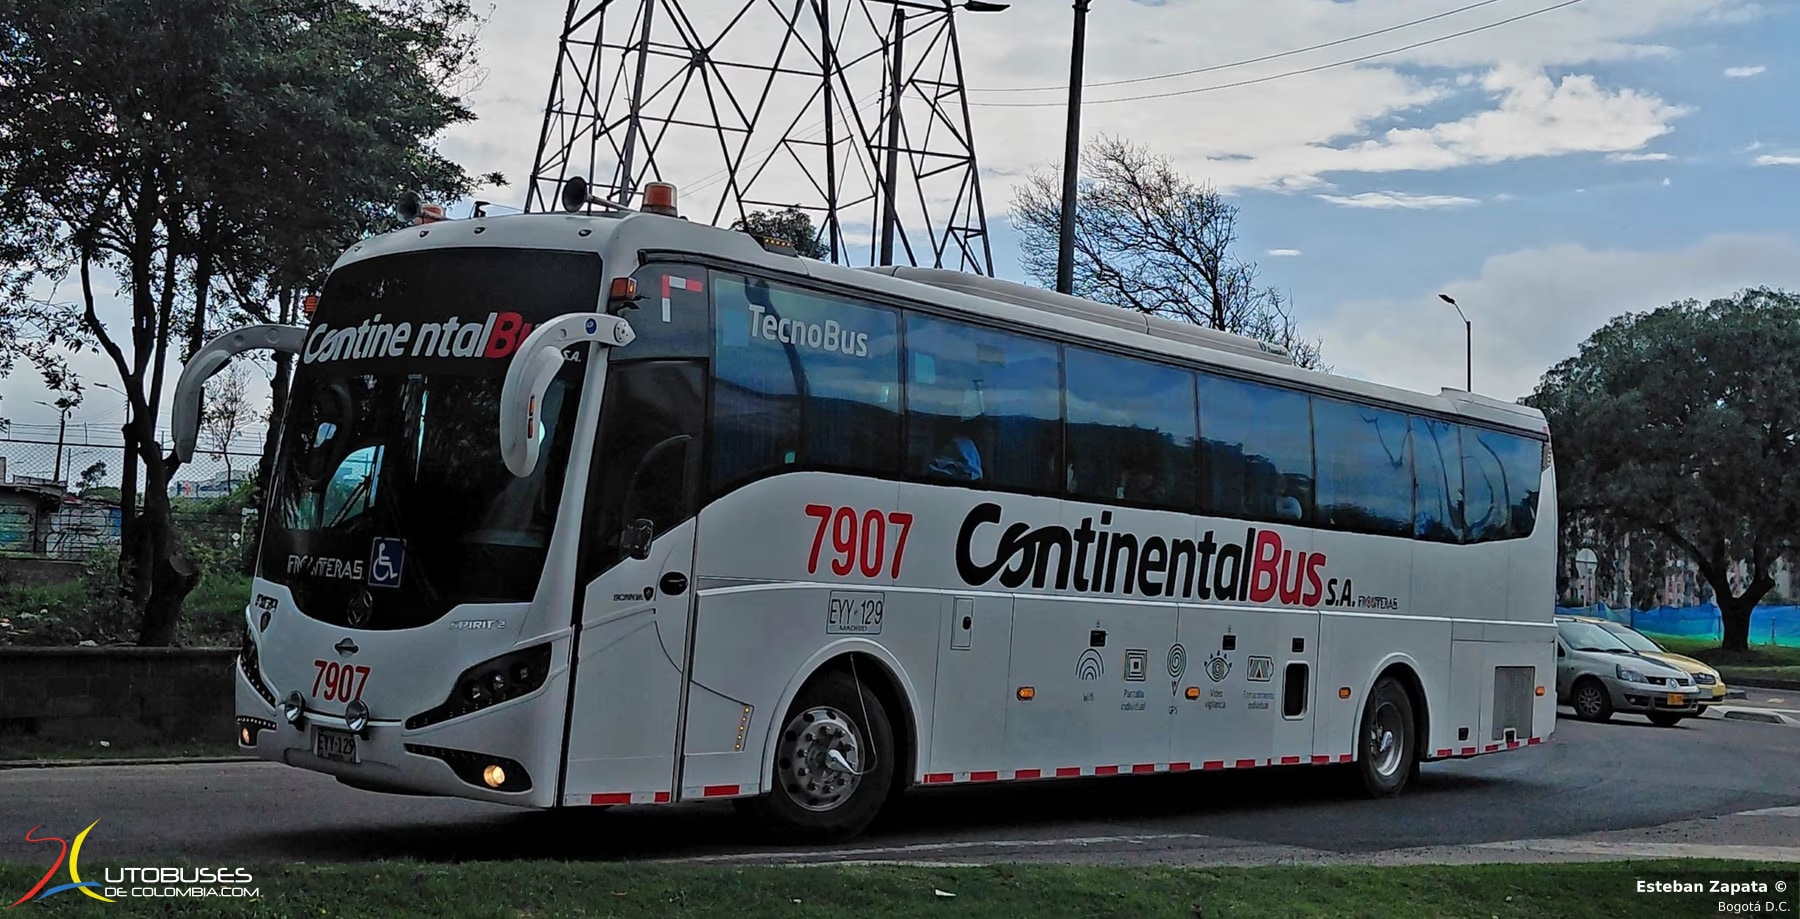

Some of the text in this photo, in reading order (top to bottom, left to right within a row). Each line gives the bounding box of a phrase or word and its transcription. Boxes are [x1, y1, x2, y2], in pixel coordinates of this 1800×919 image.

[749, 304, 868, 357] TecnoBus
[804, 504, 914, 580] 7907
[955, 501, 1326, 607] ContinentalBus
[1325, 578, 1356, 608] S.A.
[312, 659, 372, 703] 7907
